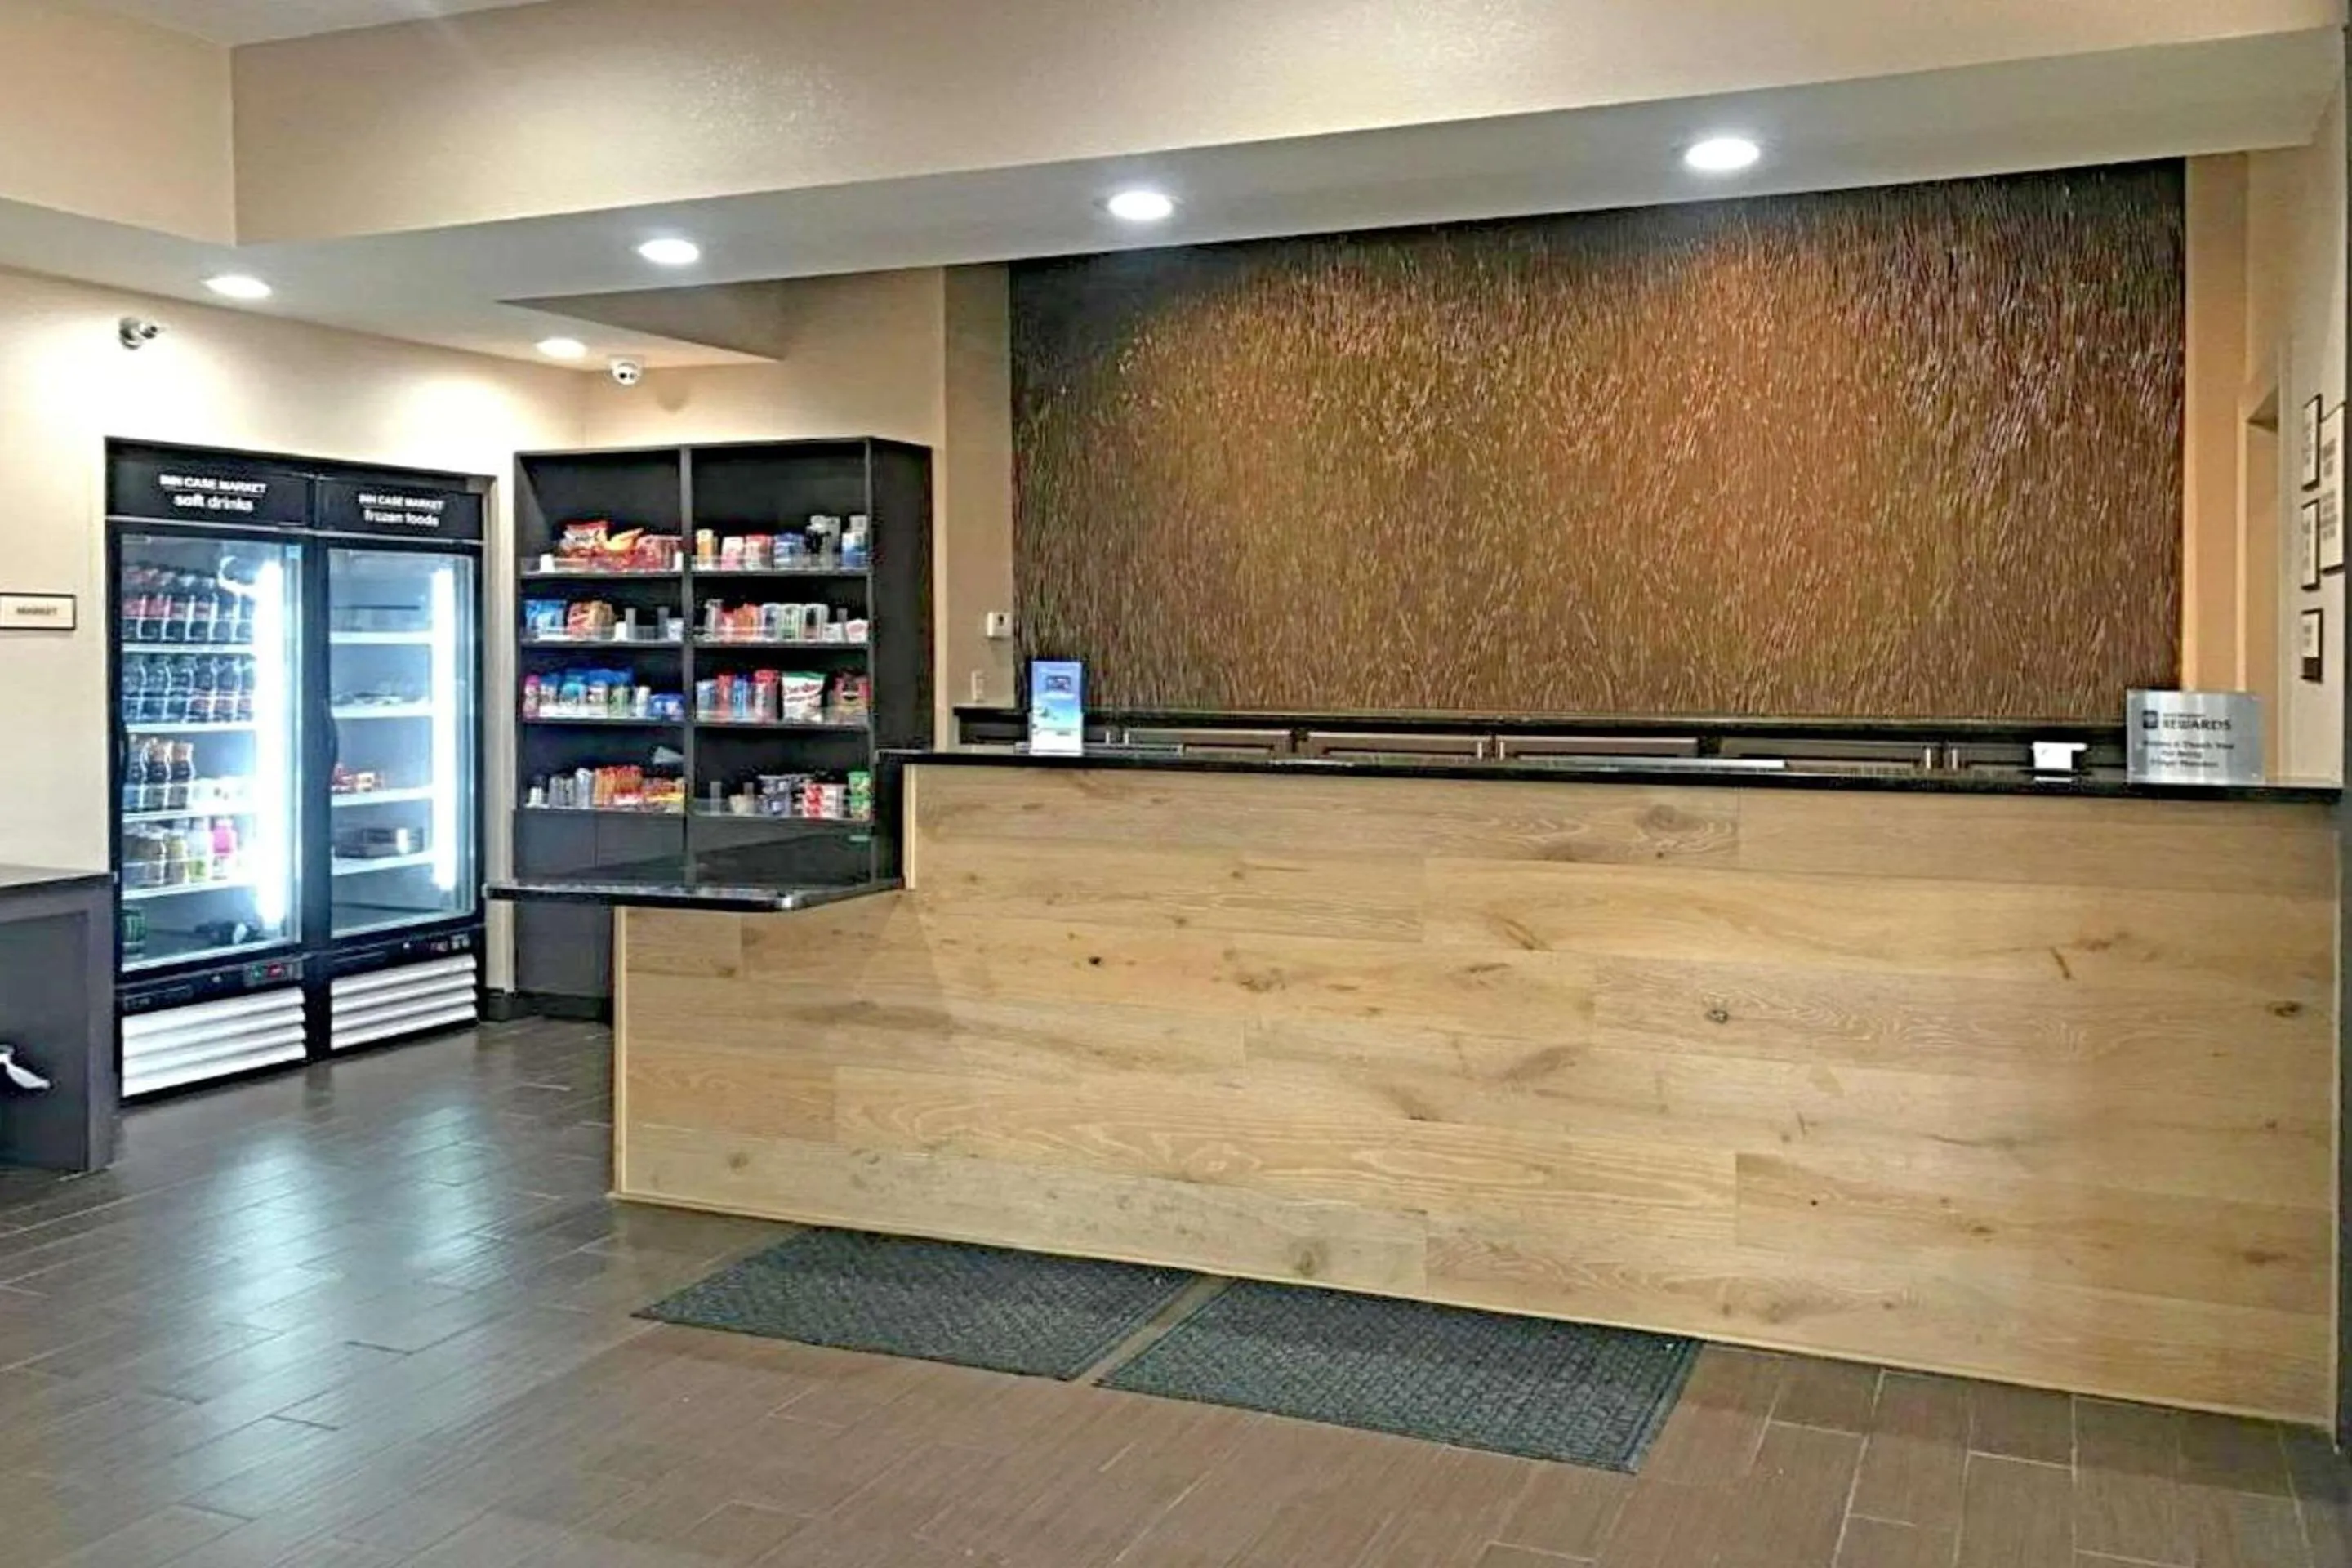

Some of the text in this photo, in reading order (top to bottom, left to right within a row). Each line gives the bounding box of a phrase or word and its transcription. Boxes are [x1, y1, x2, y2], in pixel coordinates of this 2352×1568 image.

[185, 477, 216, 489] CASE
[218, 480, 266, 493] MARKET
[174, 493, 253, 512] soft drinks
[404, 497, 444, 510] MARKET
[364, 509, 439, 528] frozen foods
[2163, 719, 2231, 730] REWARDS
